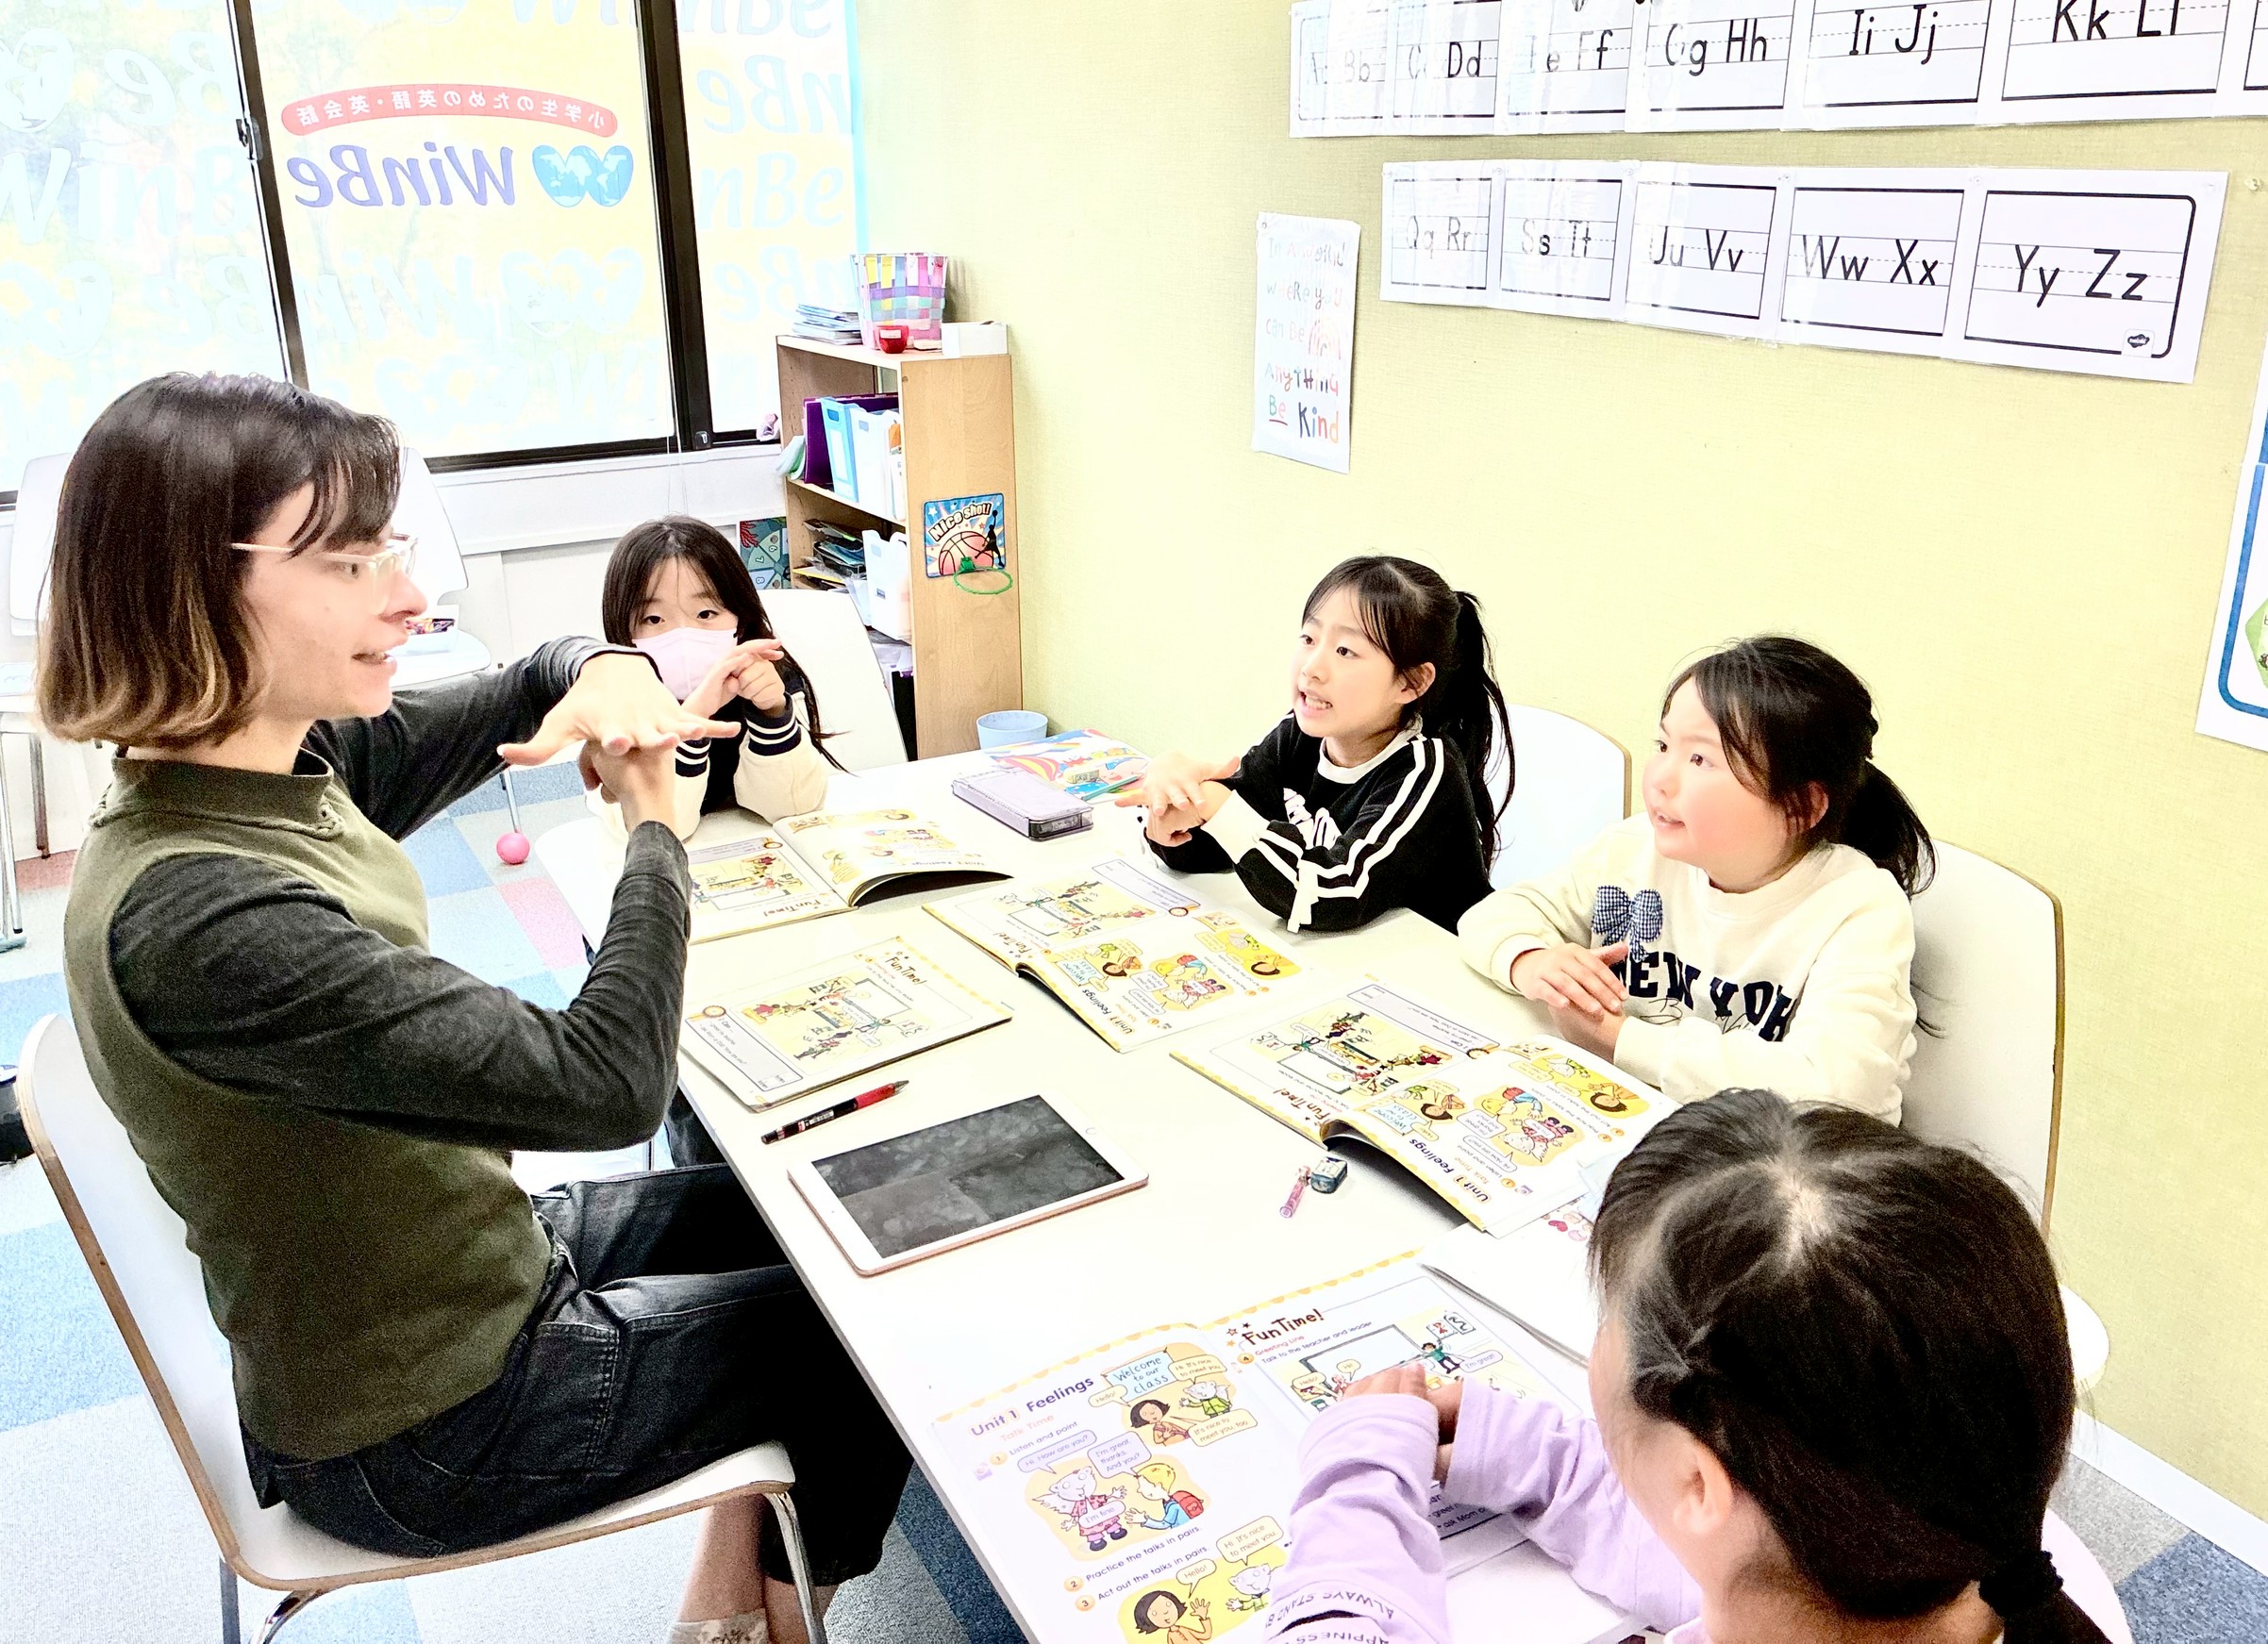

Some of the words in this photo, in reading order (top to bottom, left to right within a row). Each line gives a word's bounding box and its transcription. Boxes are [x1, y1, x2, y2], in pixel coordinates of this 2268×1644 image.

[1849, 8, 1876, 56] Ii
[1894, 3, 1940, 65] Jj
[2052, 0, 2110, 43] Kk
[1447, 40, 1482, 79] Dd
[1576, 29, 1614, 71] Ff
[1665, 23, 1709, 77] Gg
[1726, 17, 1768, 63] Hh
[1448, 216, 1472, 252] Rr
[1521, 218, 1551, 257] Ss
[1568, 220, 1593, 258] Tt
[1705, 228, 1743, 272] Vv
[1802, 234, 1869, 282] Ww
[1890, 238, 1939, 286] Xx
[2014, 243, 2060, 308] Yy
[2085, 248, 2149, 301] Zz
[1081, 988, 1111, 1015] Feelings
[1407, 1138, 1455, 1173] Feelings
[1460, 1181, 1490, 1202] Unit
[1261, 1353, 1277, 1365] Talk
[1332, 1328, 1347, 1338] and
[1112, 1356, 1162, 1383] Welcome
[1133, 1373, 1144, 1383] to
[1145, 1368, 1159, 1378] our
[971, 1414, 1007, 1436] Unit
[1009, 1409, 1018, 1420] 1
[1026, 1377, 1094, 1413] Feelings
[1000, 1426, 1026, 1443] Talk
[1026, 1415, 1055, 1432] Time
[1009, 1441, 1035, 1456] Listen
[1036, 1432, 1054, 1444] and
[1056, 1420, 1078, 1436] point
[1056, 1444, 1070, 1453] are
[1072, 1435, 1089, 1449] you?
[1199, 1430, 1219, 1443] meet
[1248, 1524, 1265, 1536] nice
[1456, 1509, 1478, 1523] Mom
[1086, 1560, 1126, 1583] Practice
[1126, 1552, 1142, 1563] the
[1143, 1542, 1165, 1555] talks
[1167, 1536, 1176, 1546] in
[1229, 1550, 1240, 1558] to
[1240, 1538, 1260, 1553] meet
[1070, 1580, 1077, 1588] 2
[1098, 1588, 1114, 1601] Act
[1116, 1581, 1132, 1593] out
[1133, 1572, 1149, 1584] the
[1150, 1562, 1173, 1575] talks
[1174, 1556, 1184, 1566] in
[1183, 1565, 1208, 1580] Hello!
